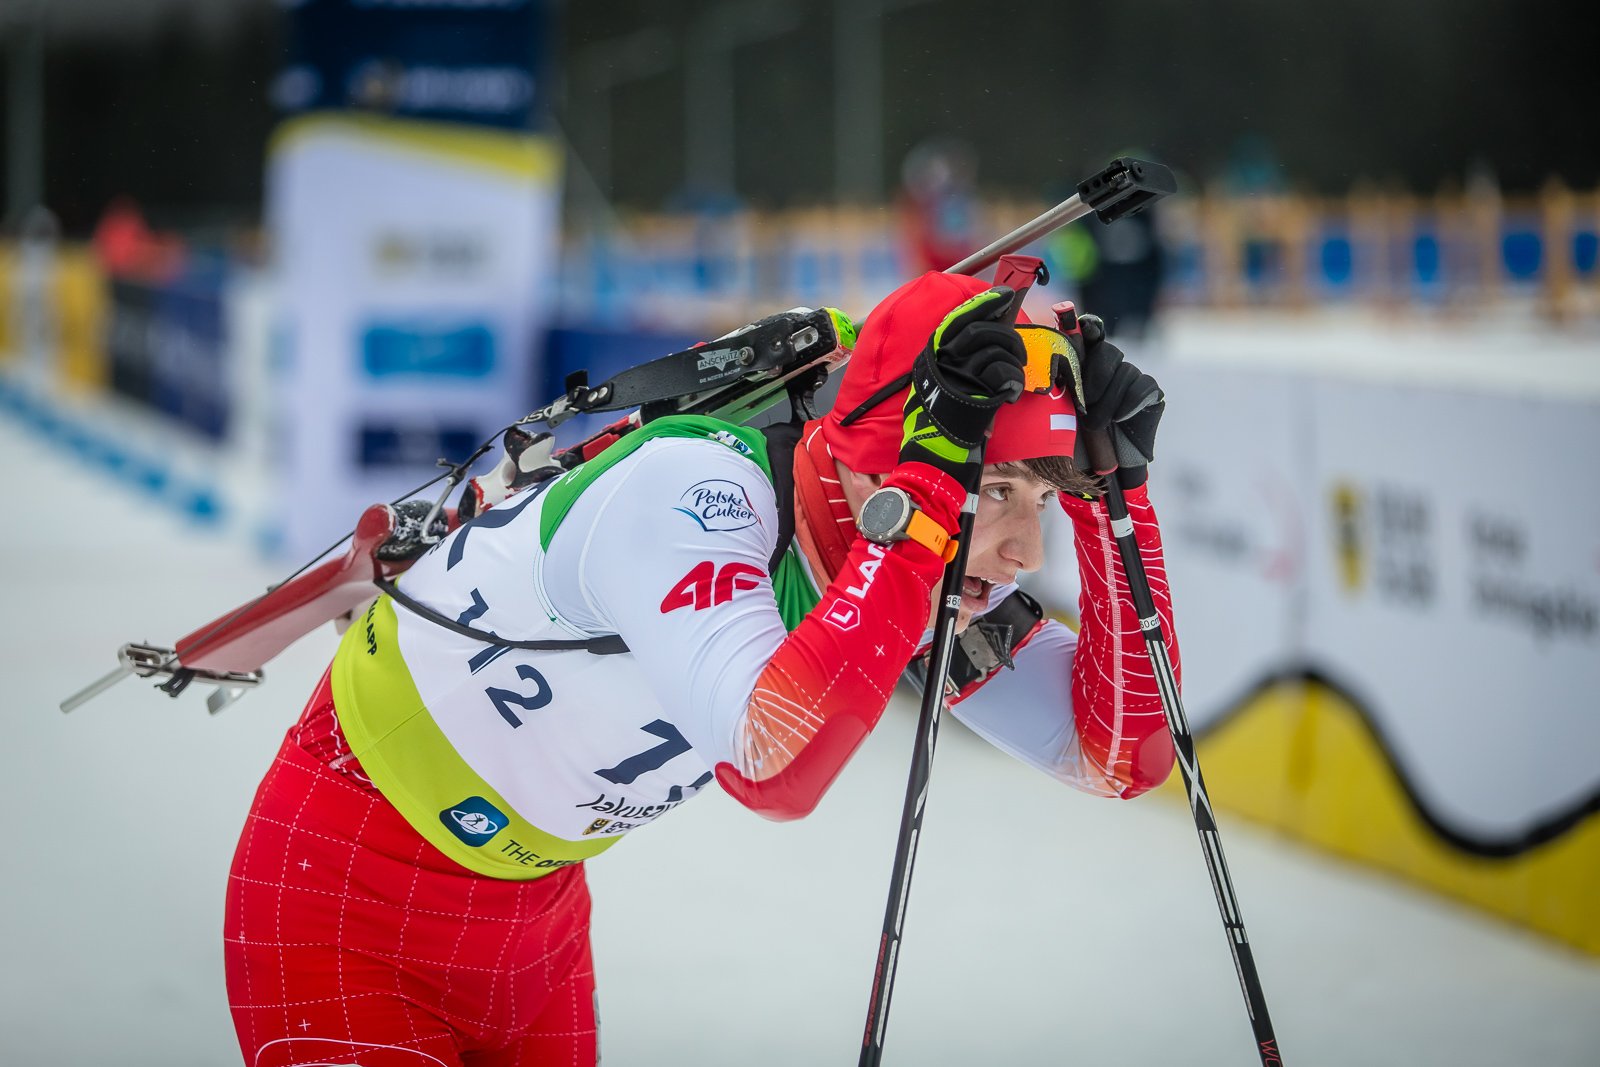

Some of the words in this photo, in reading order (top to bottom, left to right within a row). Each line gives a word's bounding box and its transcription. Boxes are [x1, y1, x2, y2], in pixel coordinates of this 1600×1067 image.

[702, 503, 754, 519] Cukier
[660, 560, 767, 613] 4F
[501, 839, 540, 865] THE
